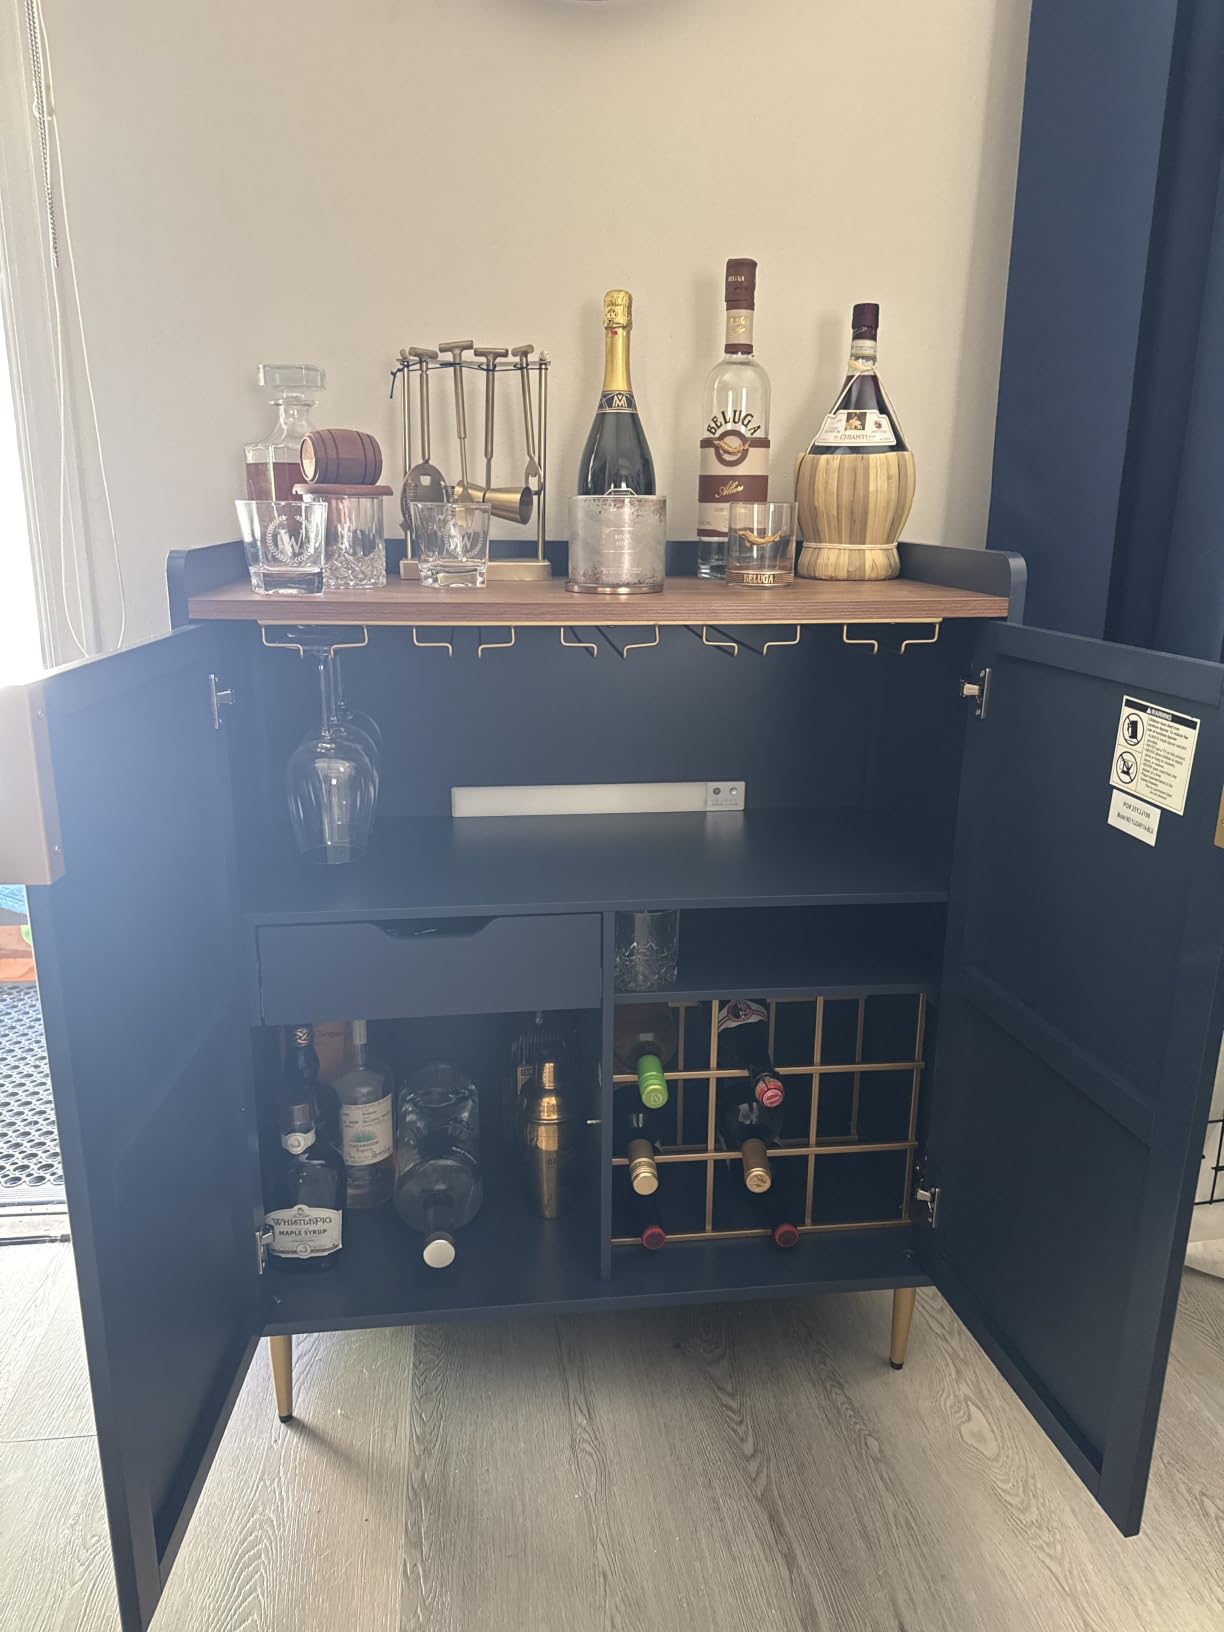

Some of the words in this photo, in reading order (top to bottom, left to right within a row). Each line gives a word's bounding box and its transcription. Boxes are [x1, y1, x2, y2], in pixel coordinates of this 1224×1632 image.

[706, 409, 761, 436] BELUGA
[839, 432, 868, 441] CHIANTI
[743, 573, 774, 584] BELUGA
[1151, 709, 1172, 721] WARNING
[304, 1228, 328, 1236] SYRUP
